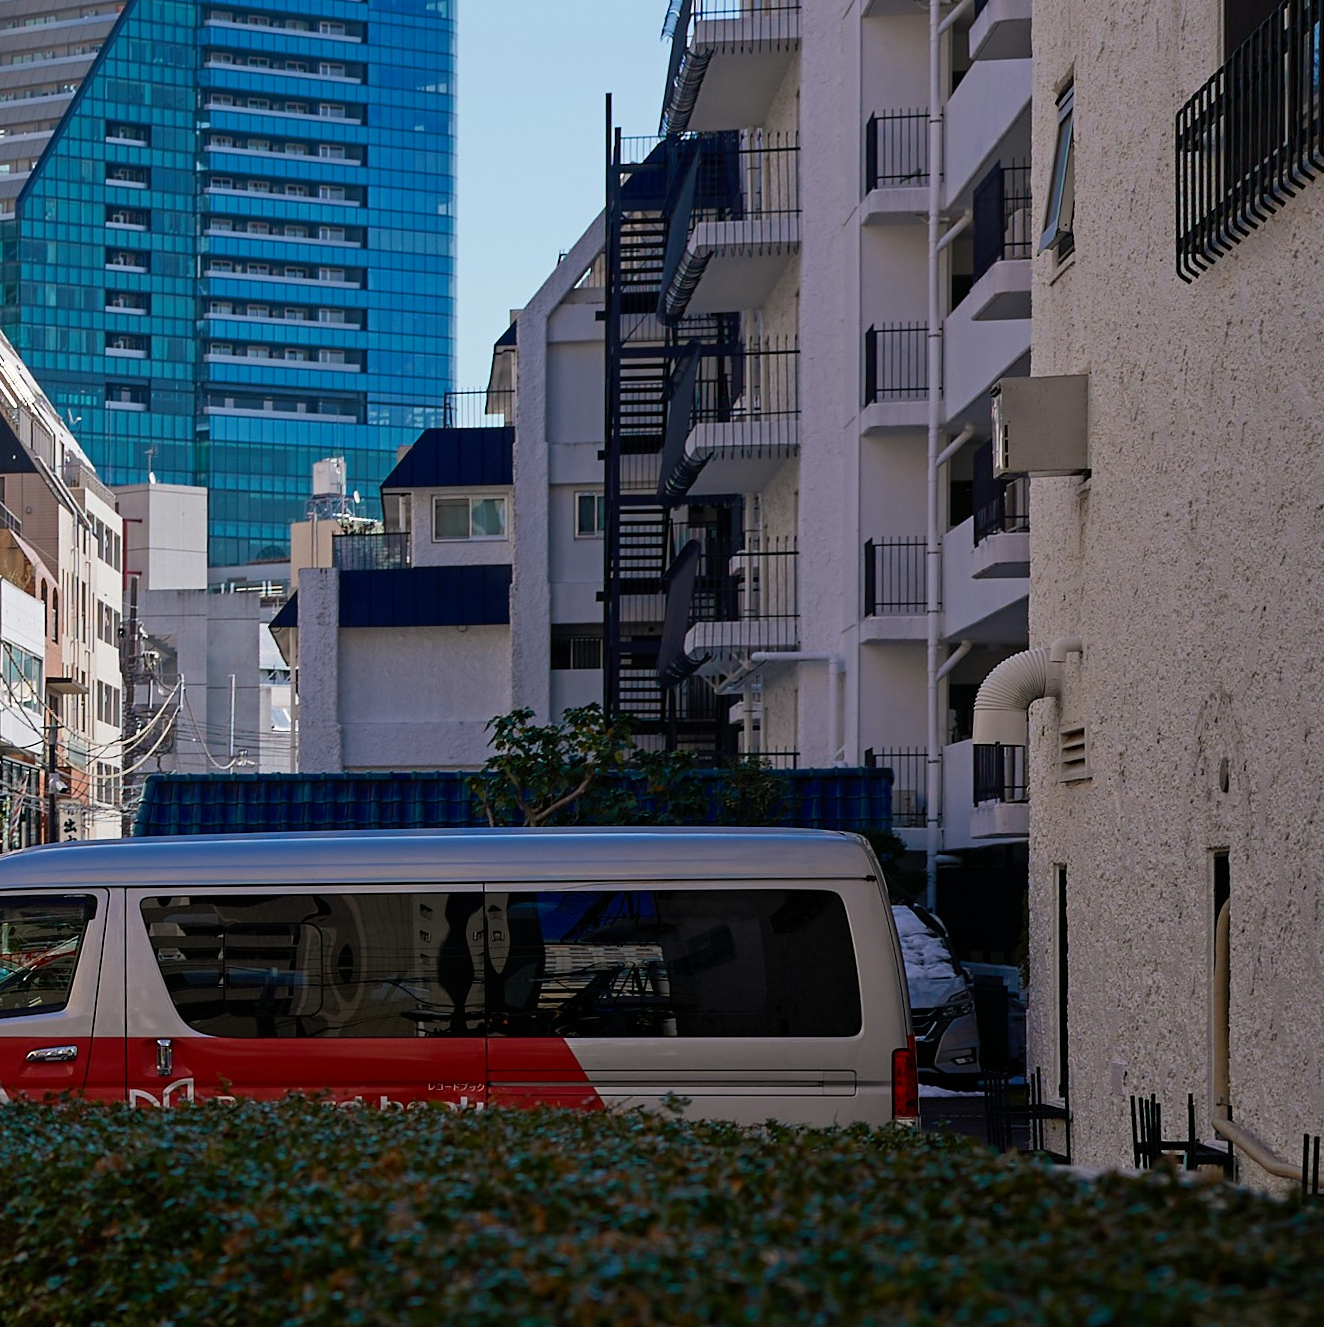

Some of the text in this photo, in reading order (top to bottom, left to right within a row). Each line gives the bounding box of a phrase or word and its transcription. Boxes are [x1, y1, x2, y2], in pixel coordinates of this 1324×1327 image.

[428, 1083, 485, 1092] レコードブック
